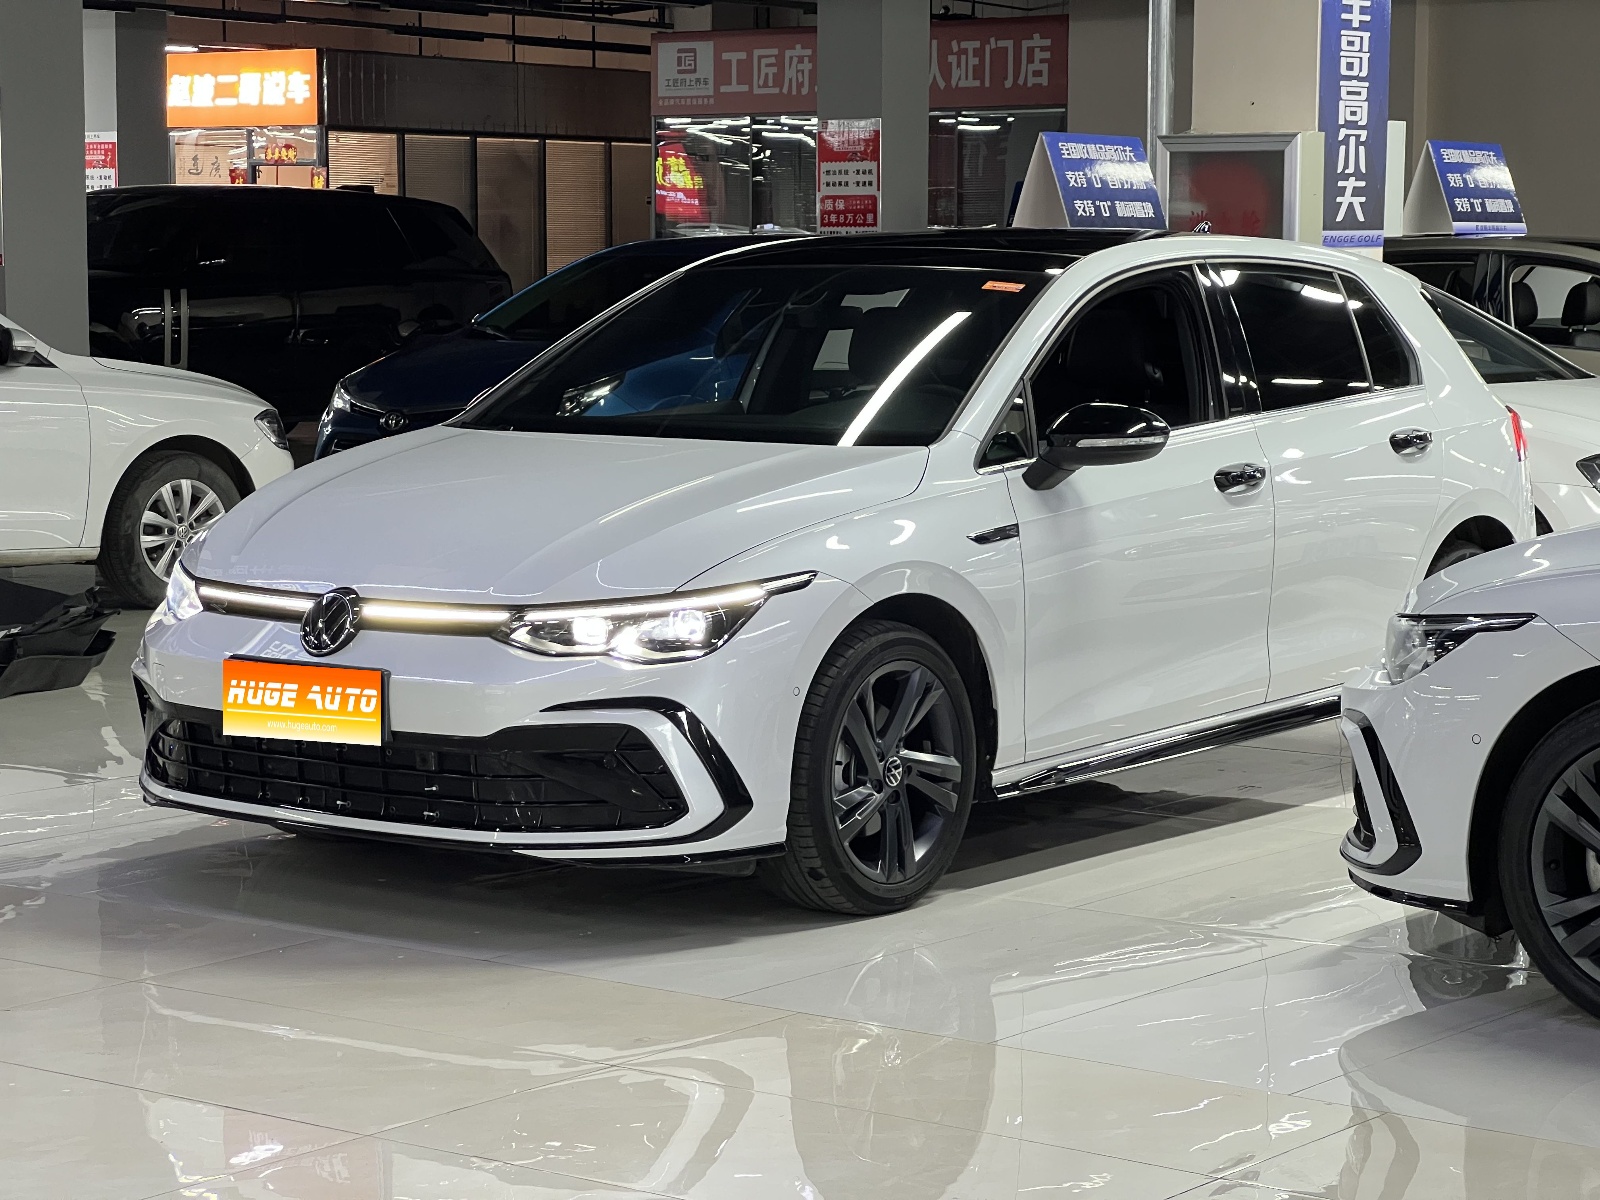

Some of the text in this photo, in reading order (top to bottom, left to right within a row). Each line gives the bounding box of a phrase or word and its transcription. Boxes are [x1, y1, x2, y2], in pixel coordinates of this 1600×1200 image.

[720, 44, 817, 95] 工匠府
[824, 198, 846, 211] 质保
[823, 213, 875, 224] 3年8万公里
[1322, 234, 1382, 243] ENGGE GOLF
